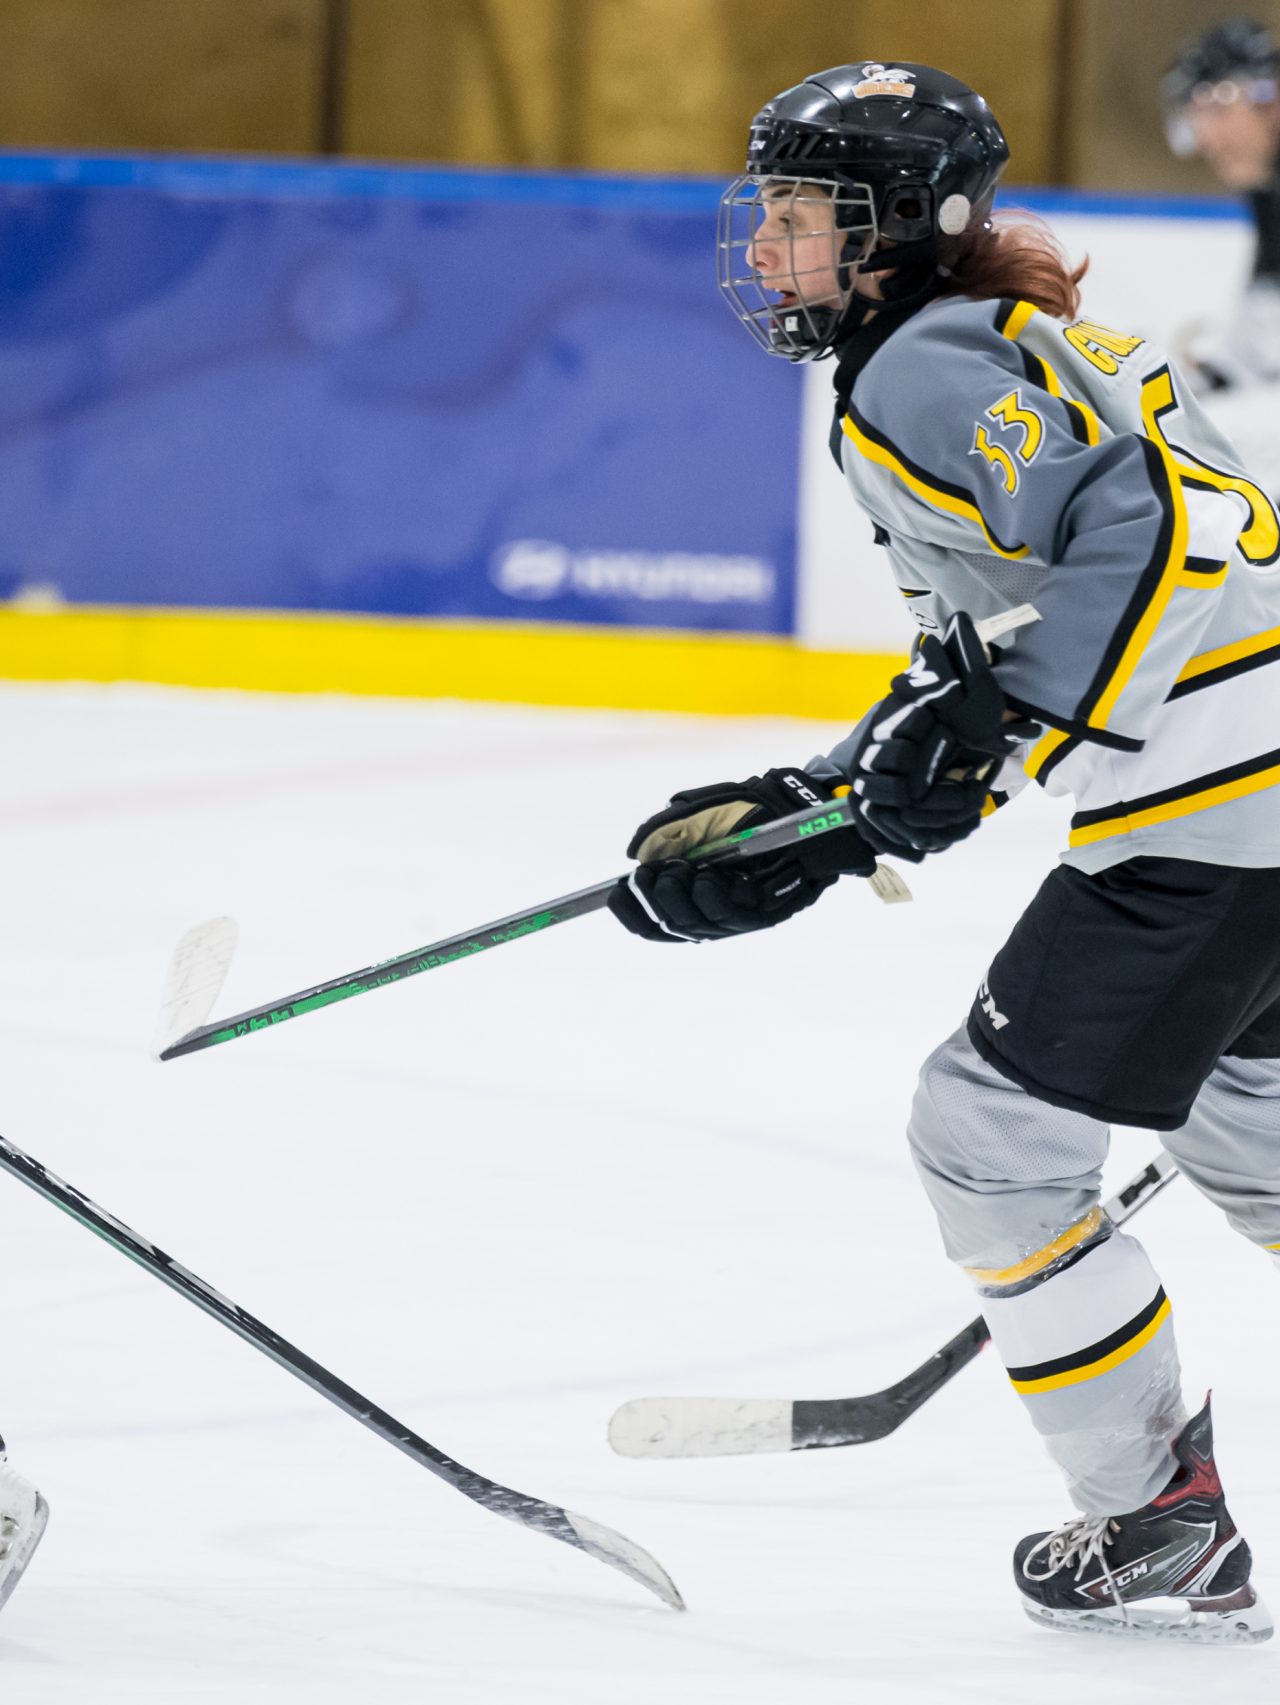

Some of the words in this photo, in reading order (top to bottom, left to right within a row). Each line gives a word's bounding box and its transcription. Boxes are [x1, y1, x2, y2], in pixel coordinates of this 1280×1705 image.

[967, 387, 1046, 499] 53
[797, 810, 845, 837] CCM
[1100, 1561, 1149, 1596] CCM
